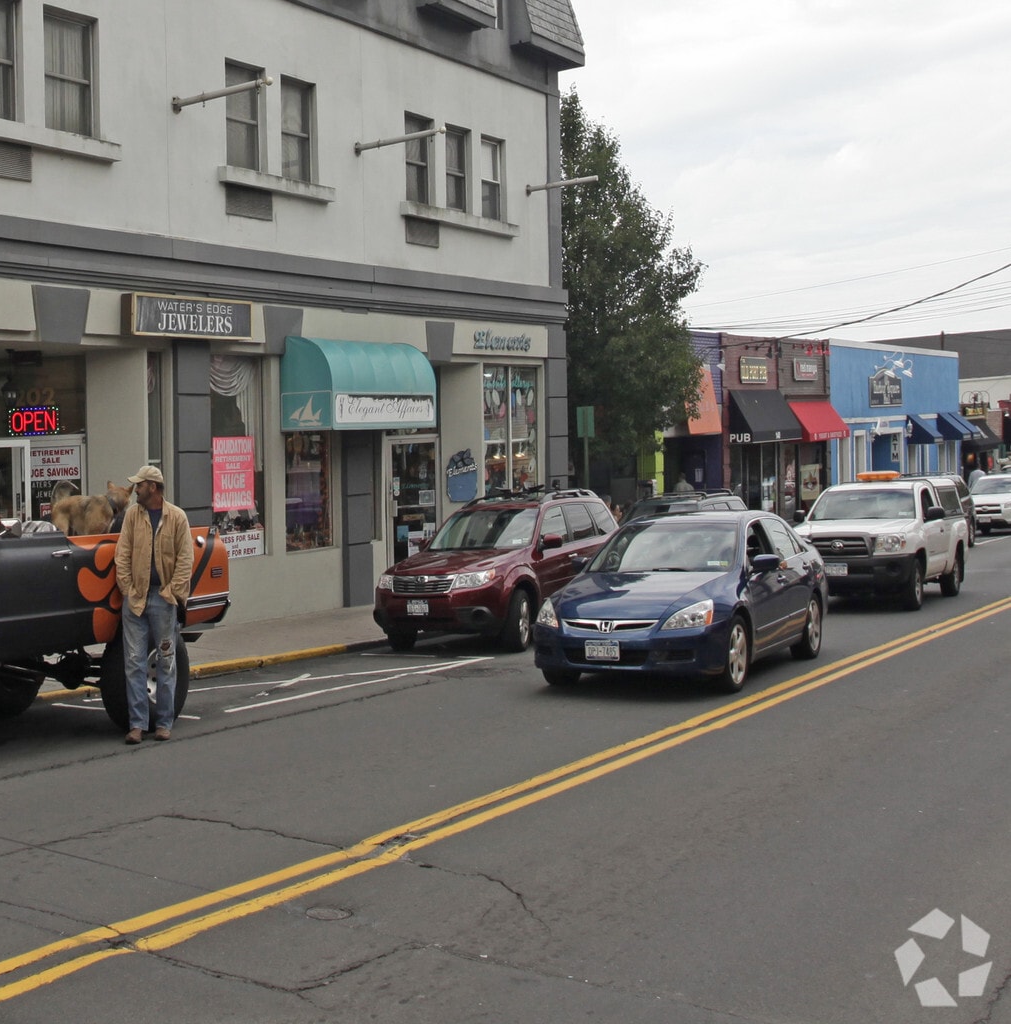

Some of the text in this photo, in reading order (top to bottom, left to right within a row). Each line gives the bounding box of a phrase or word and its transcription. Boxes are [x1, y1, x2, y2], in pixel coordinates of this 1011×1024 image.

[157, 300, 233, 315] WATER'S EDGE
[158, 313, 233, 334] JEWELERS
[348, 398, 424, 419] Elegant Affairs
[12, 410, 57, 432] OPEN
[729, 432, 751, 443] PUB
[30, 449, 75, 457] ETIREMENT
[213, 438, 252, 455] LIQUIDATION
[215, 455, 251, 463] RETIREMENT
[46, 467, 79, 478] SAVINGS
[221, 473, 245, 490] HUGE
[214, 491, 252, 509] SAVINGS
[236, 535, 246, 543] FOR
[247, 533, 260, 541] SALE
[231, 549, 242, 557] FOR
[243, 547, 257, 555] RENT
